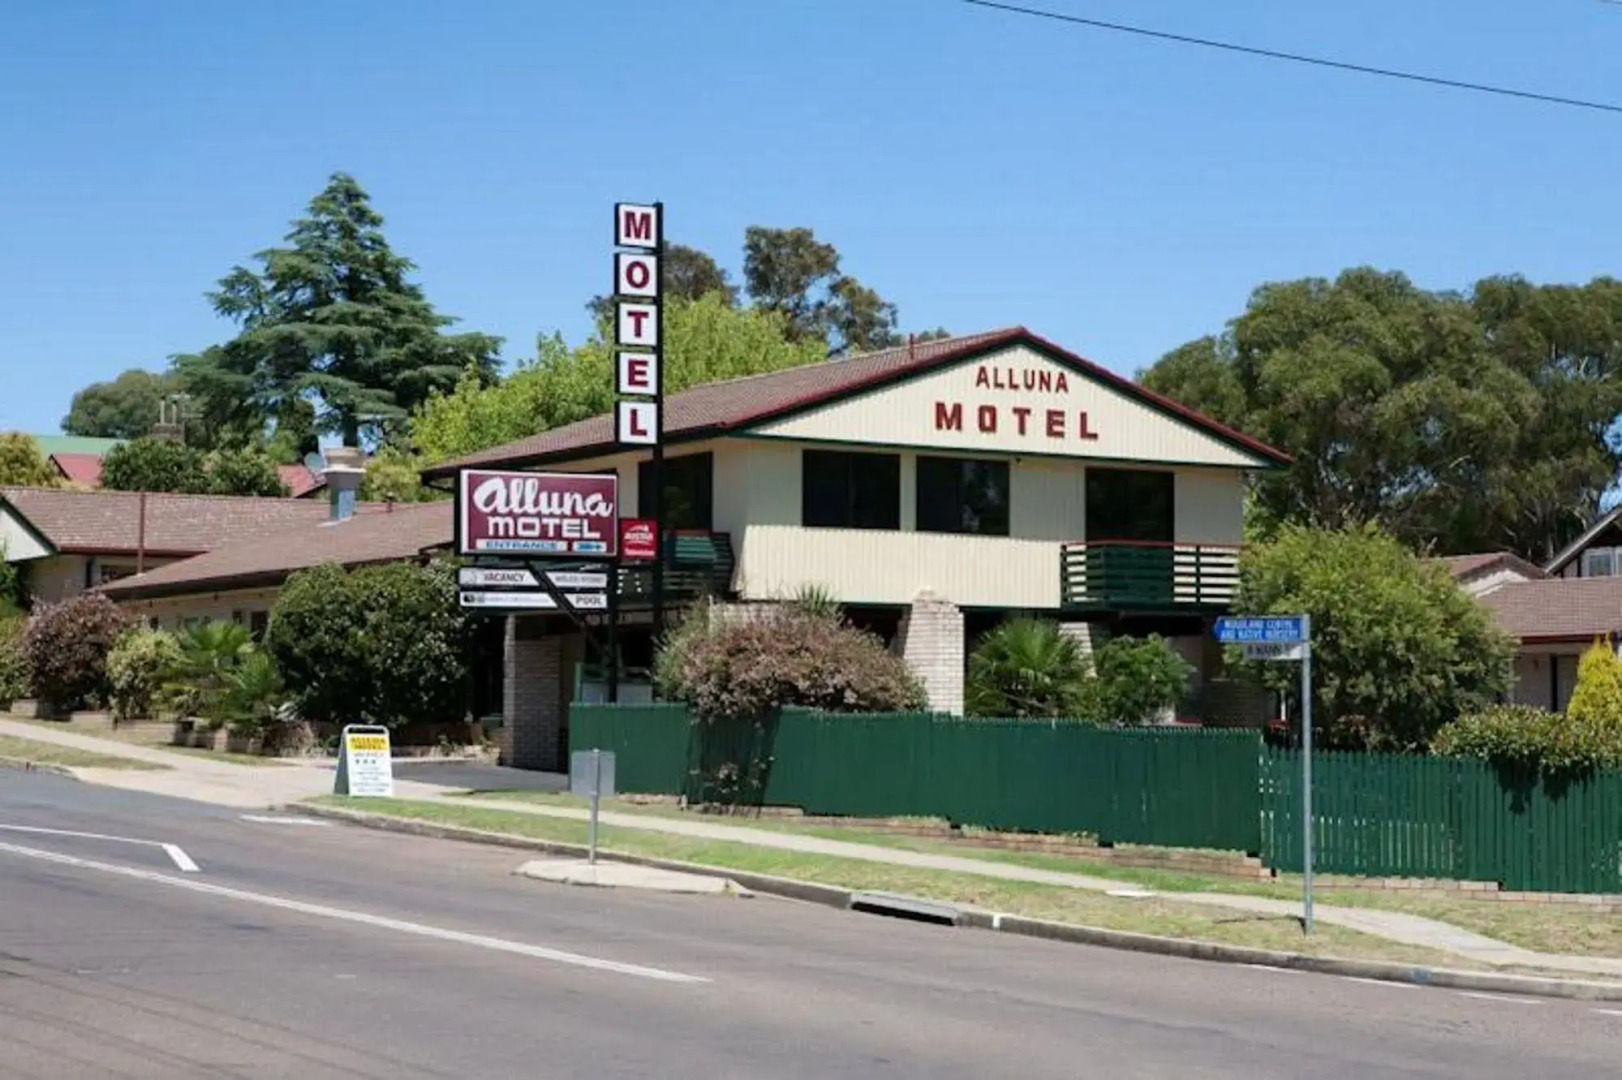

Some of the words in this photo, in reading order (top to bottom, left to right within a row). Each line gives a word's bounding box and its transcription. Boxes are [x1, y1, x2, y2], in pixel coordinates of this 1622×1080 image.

[624, 211, 651, 436] MOTEL
[975, 365, 1069, 393] ALLUNA
[935, 402, 1099, 440] MOTEL
[473, 477, 613, 517] Alluna
[487, 516, 601, 539] MOTEL
[486, 541, 558, 550] ENTRANCE
[484, 571, 526, 582] VACANCY
[1238, 629, 1262, 639] NATIVE
